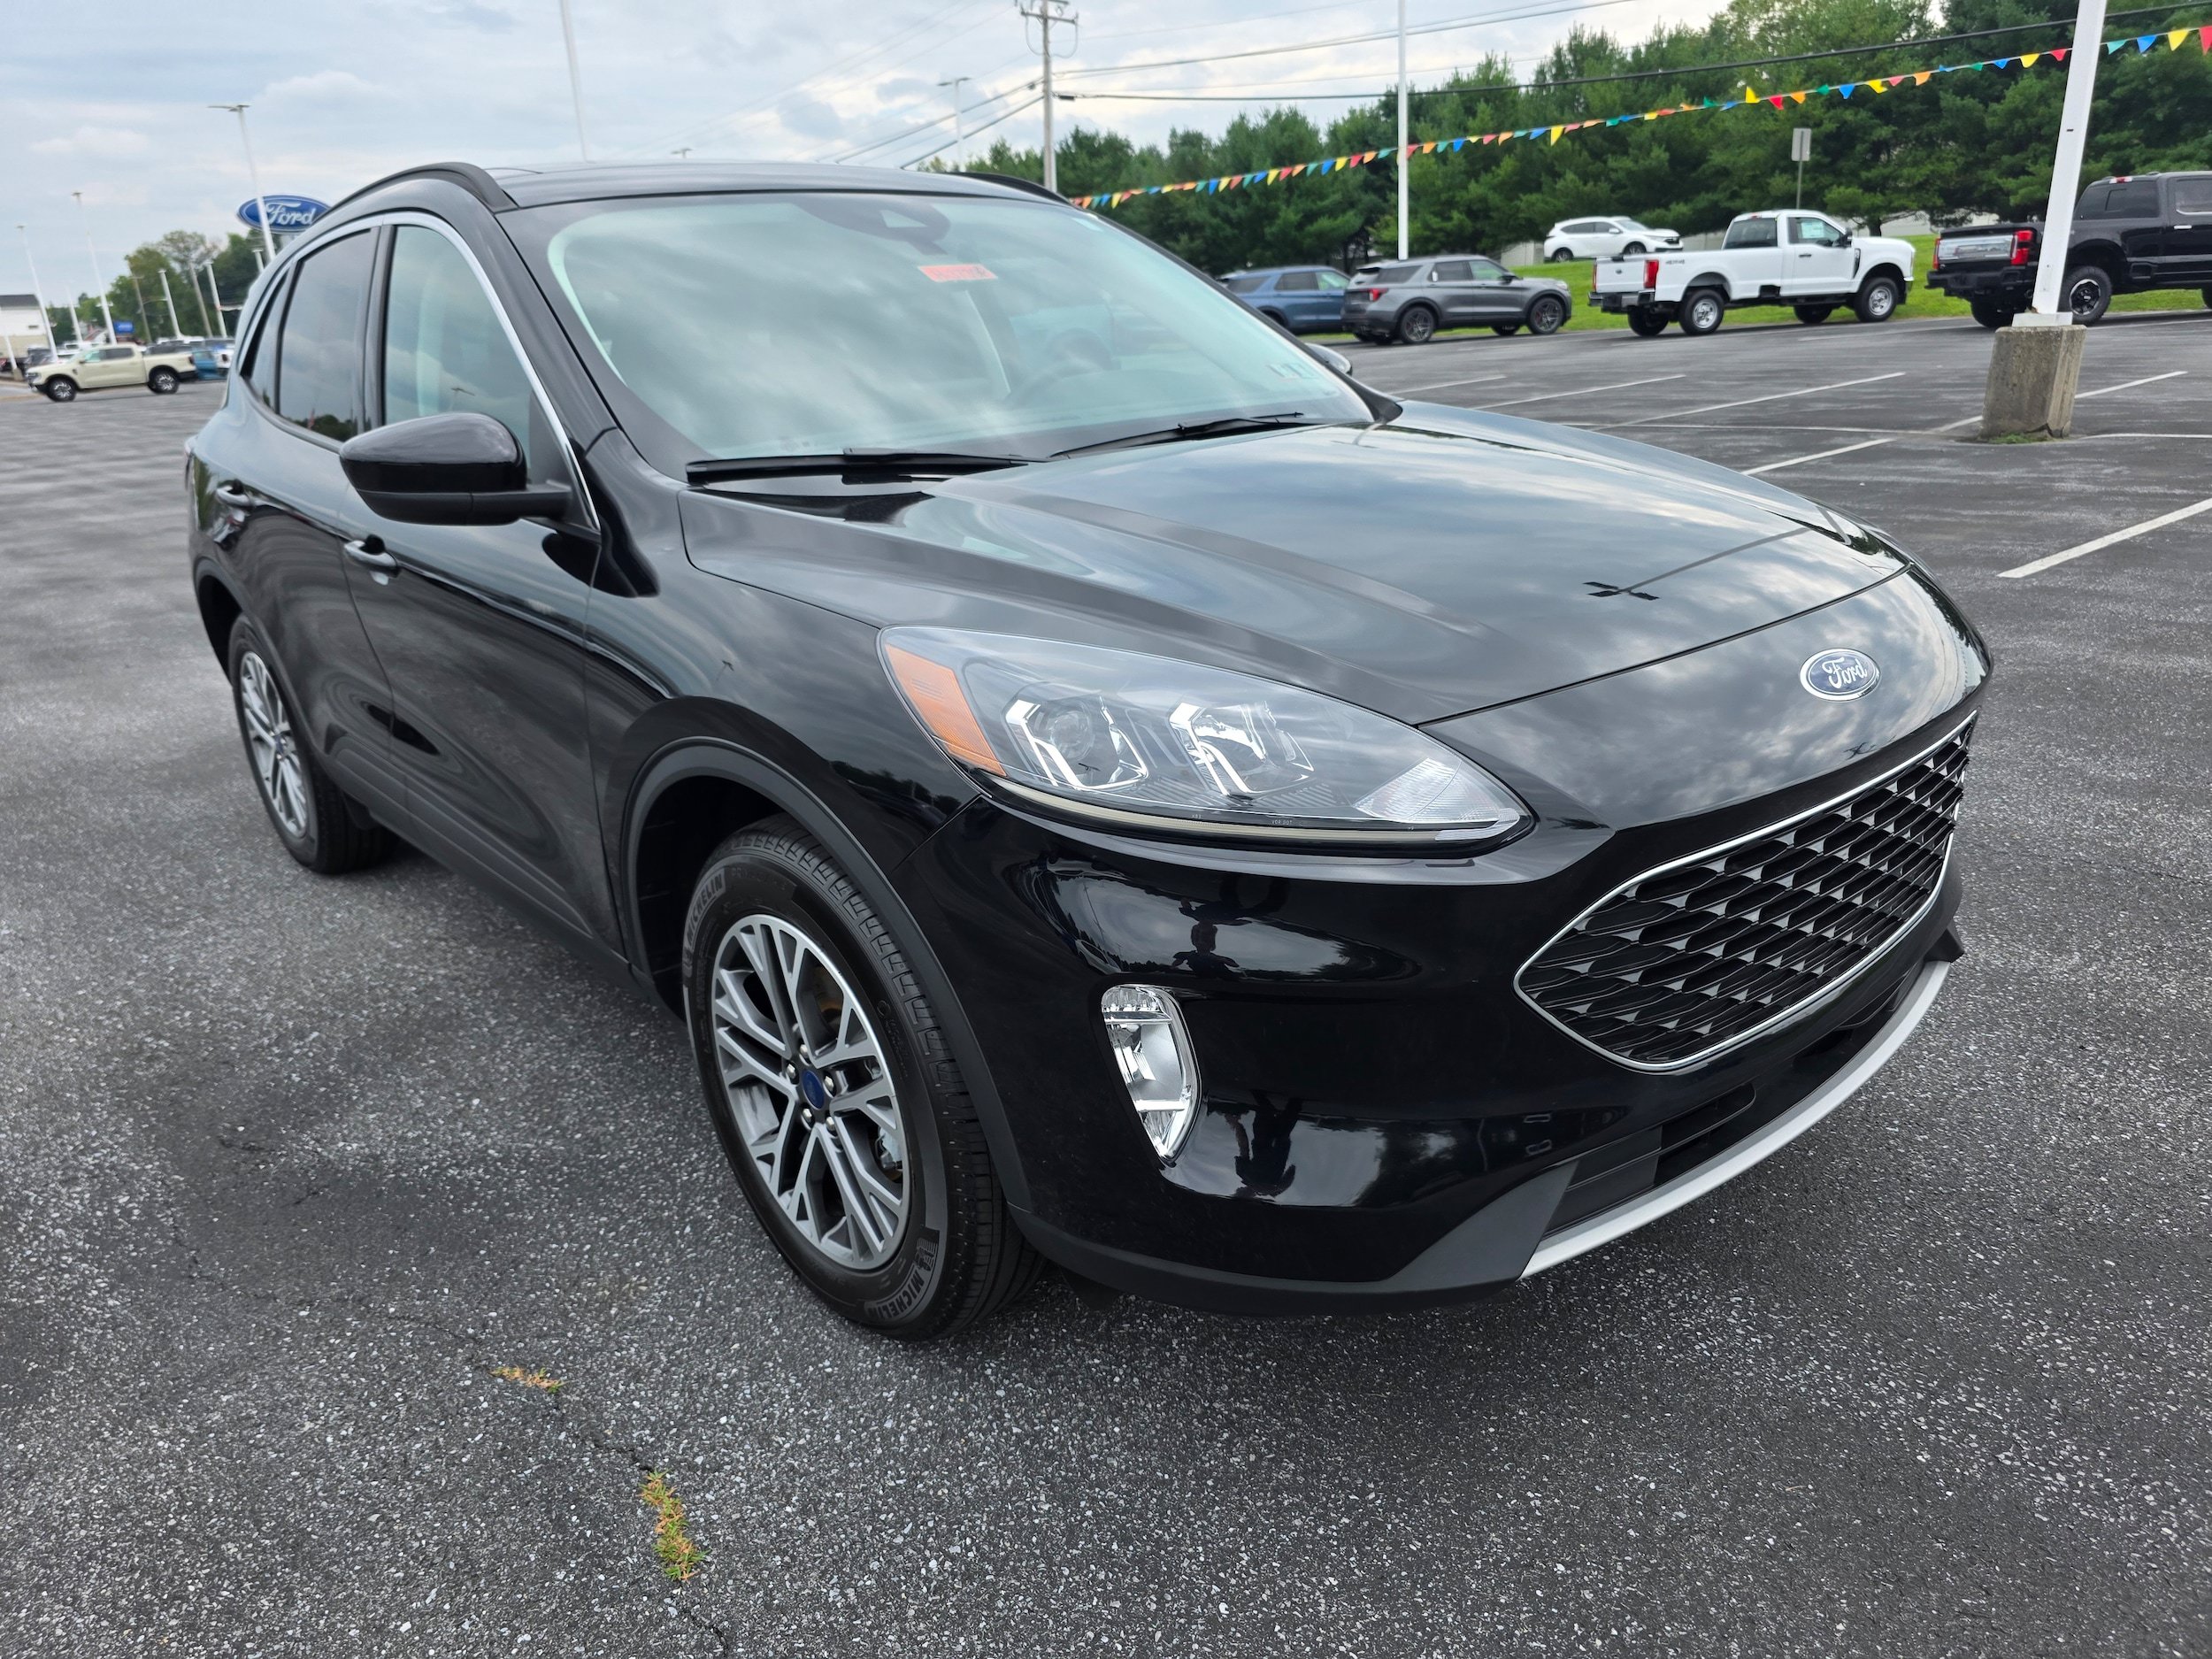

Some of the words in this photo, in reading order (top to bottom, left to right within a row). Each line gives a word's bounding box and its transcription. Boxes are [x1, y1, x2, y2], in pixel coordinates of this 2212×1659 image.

[266, 202, 317, 226] Ford
[1822, 657, 1867, 689] Ford
[687, 873, 723, 947] MICHELIN
[868, 1269, 926, 1318] MICHELIN
